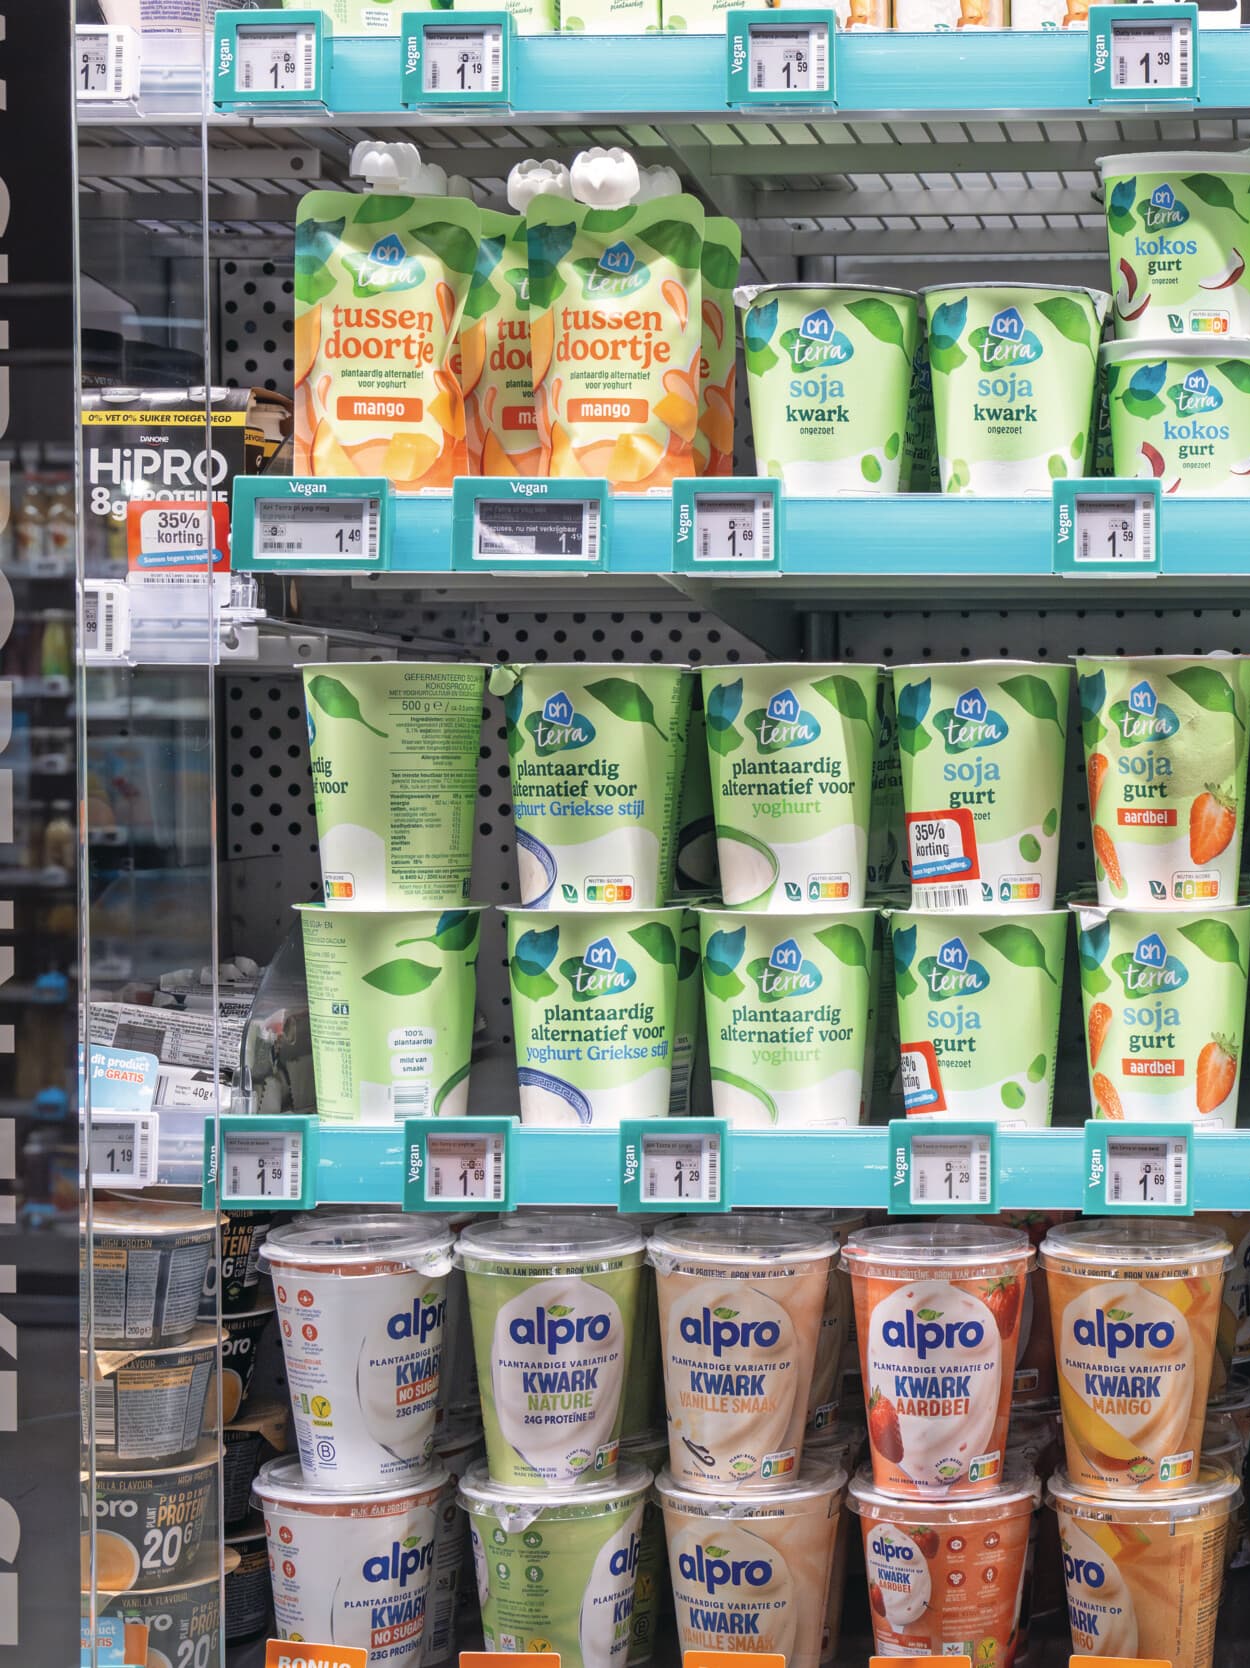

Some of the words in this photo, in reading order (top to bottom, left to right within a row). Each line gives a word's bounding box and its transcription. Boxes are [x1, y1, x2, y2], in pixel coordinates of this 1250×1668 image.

[218, 39, 232, 77] Vegan
[732, 35, 745, 74] Vegan
[1145, 208, 1183, 227] terra
[1135, 237, 1197, 256] kokos
[1148, 259, 1181, 275] gurt
[333, 304, 433, 332] tussen
[325, 331, 434, 368] doortje
[791, 340, 847, 364] terra
[341, 369, 382, 379] plantaardig
[384, 370, 424, 379] alternatief
[358, 381, 374, 389] voor
[376, 380, 406, 389] yoghurt
[790, 374, 844, 404] soja
[88, 414, 102, 422] 0%
[353, 401, 405, 418] mango
[786, 406, 849, 423] kwark
[800, 426, 834, 435] ongezoet
[90, 448, 228, 486] HiPRO
[289, 481, 327, 495] Vegan
[510, 482, 548, 495] Vegan
[91, 487, 127, 521] 8g
[158, 512, 200, 528] 35%
[677, 504, 691, 543] Vegan
[158, 531, 203, 546] korting
[943, 756, 1000, 788] soja
[1117, 750, 1172, 781] soja
[950, 788, 995, 808] gurt
[1124, 782, 1168, 802] gurt
[752, 799, 822, 818] yoghurt
[915, 825, 945, 841] 35%
[916, 842, 949, 857] korting
[544, 1003, 654, 1026] plantaardig
[394, 1037, 433, 1047] plantaardig
[531, 1024, 628, 1042] alternatief
[631, 1025, 665, 1040] voor
[399, 1056, 416, 1064] mild
[527, 1044, 583, 1063] yoghurt
[586, 1044, 648, 1060] Griekse
[651, 1041, 668, 1061] stijl
[403, 1064, 424, 1072] smaak
[192, 1088, 209, 1099] 40g
[408, 1145, 422, 1182] Vegan
[624, 1145, 637, 1183] Vegan
[509, 1306, 611, 1355] alpro
[680, 1308, 780, 1356] alpro
[499, 1360, 566, 1369] PLANTAARDIGE
[570, 1356, 607, 1367] VARIATIE
[522, 1368, 598, 1394] KWARK
[690, 1374, 765, 1396] KWARK
[895, 1375, 970, 1397] KWARK
[1085, 1375, 1161, 1398] KWARK
[527, 1392, 593, 1411] NATURE
[680, 1394, 729, 1412] VANILLE
[732, 1394, 777, 1412] SMAAK
[897, 1400, 969, 1416] AARDBEI
[1093, 1398, 1151, 1416] MANGO
[524, 1415, 542, 1424] 24G
[545, 1411, 587, 1424] PROTEÏNE
